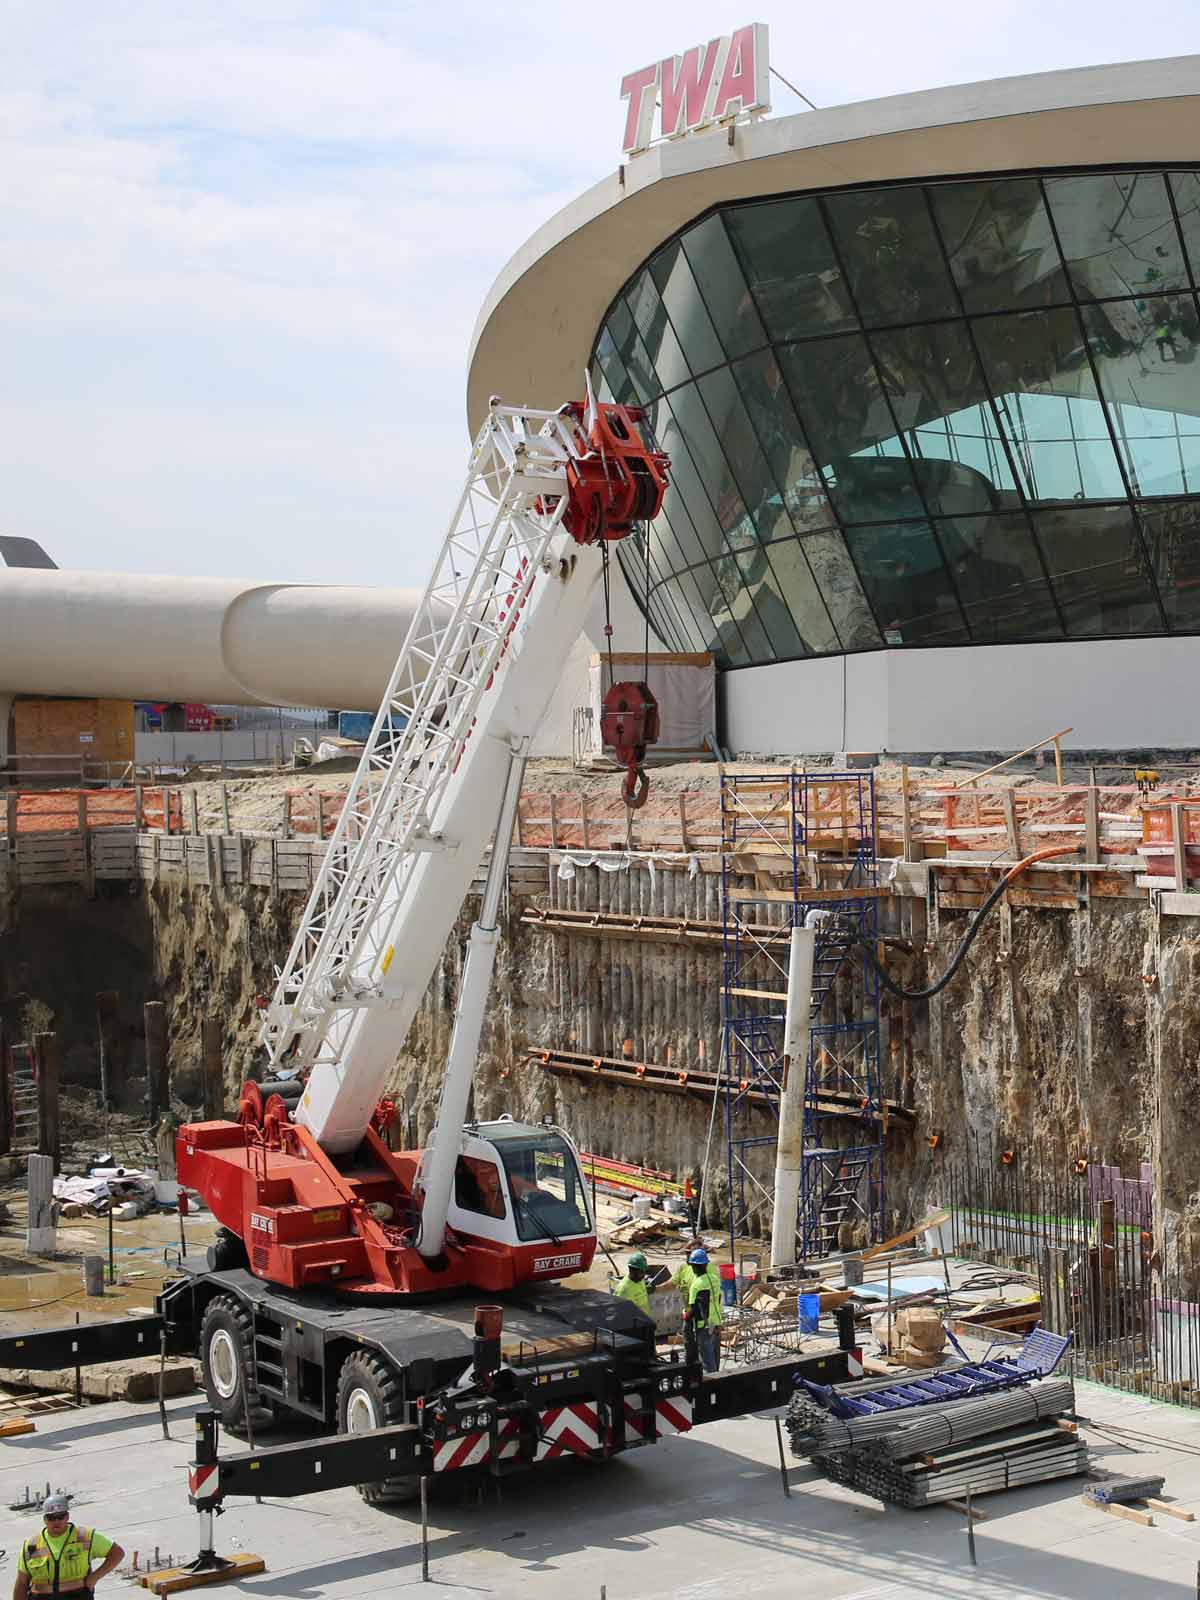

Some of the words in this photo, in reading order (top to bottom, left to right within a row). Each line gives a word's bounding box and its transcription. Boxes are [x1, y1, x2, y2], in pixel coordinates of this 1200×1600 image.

[620, 22, 769, 153] TWA
[535, 1260, 550, 1270] BAY
[553, 1256, 581, 1267] CRANE
